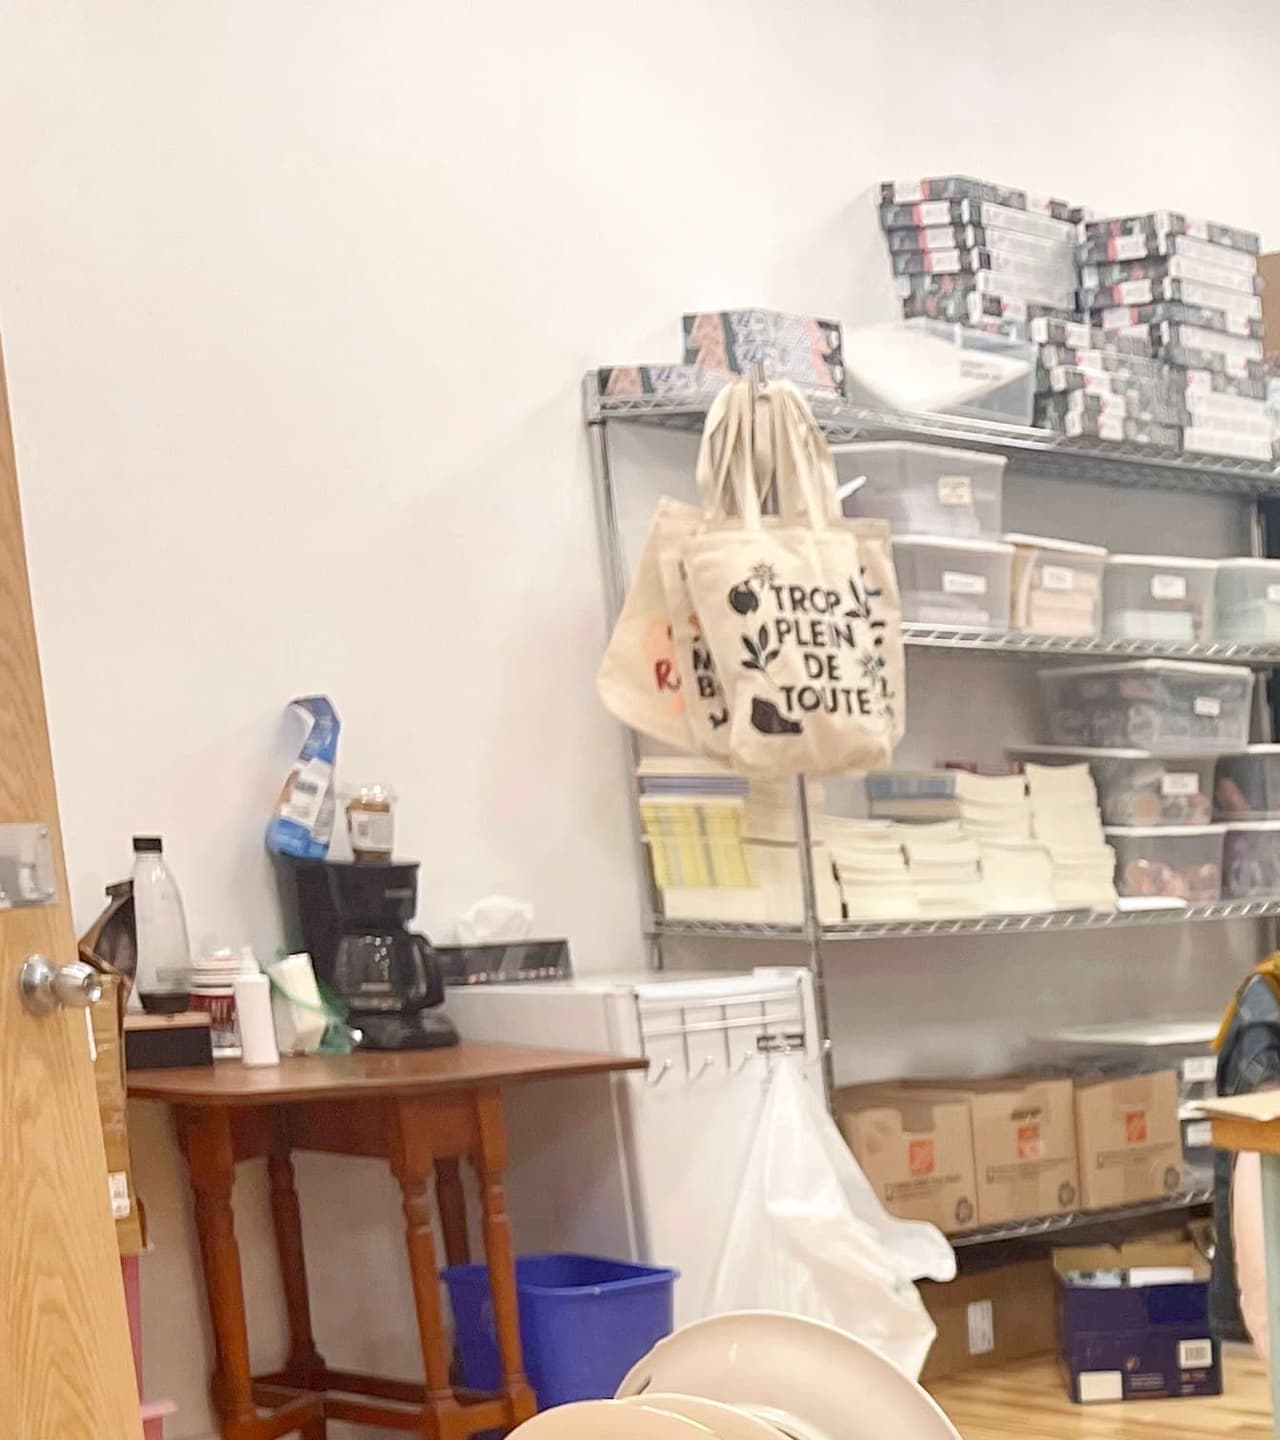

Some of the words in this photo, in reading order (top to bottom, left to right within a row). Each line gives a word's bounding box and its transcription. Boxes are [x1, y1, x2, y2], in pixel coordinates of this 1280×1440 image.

[770, 585, 840, 614] TROP
[775, 618, 856, 648] PLEIN
[804, 653, 840, 680] DE
[779, 685, 872, 715] TOUTE
